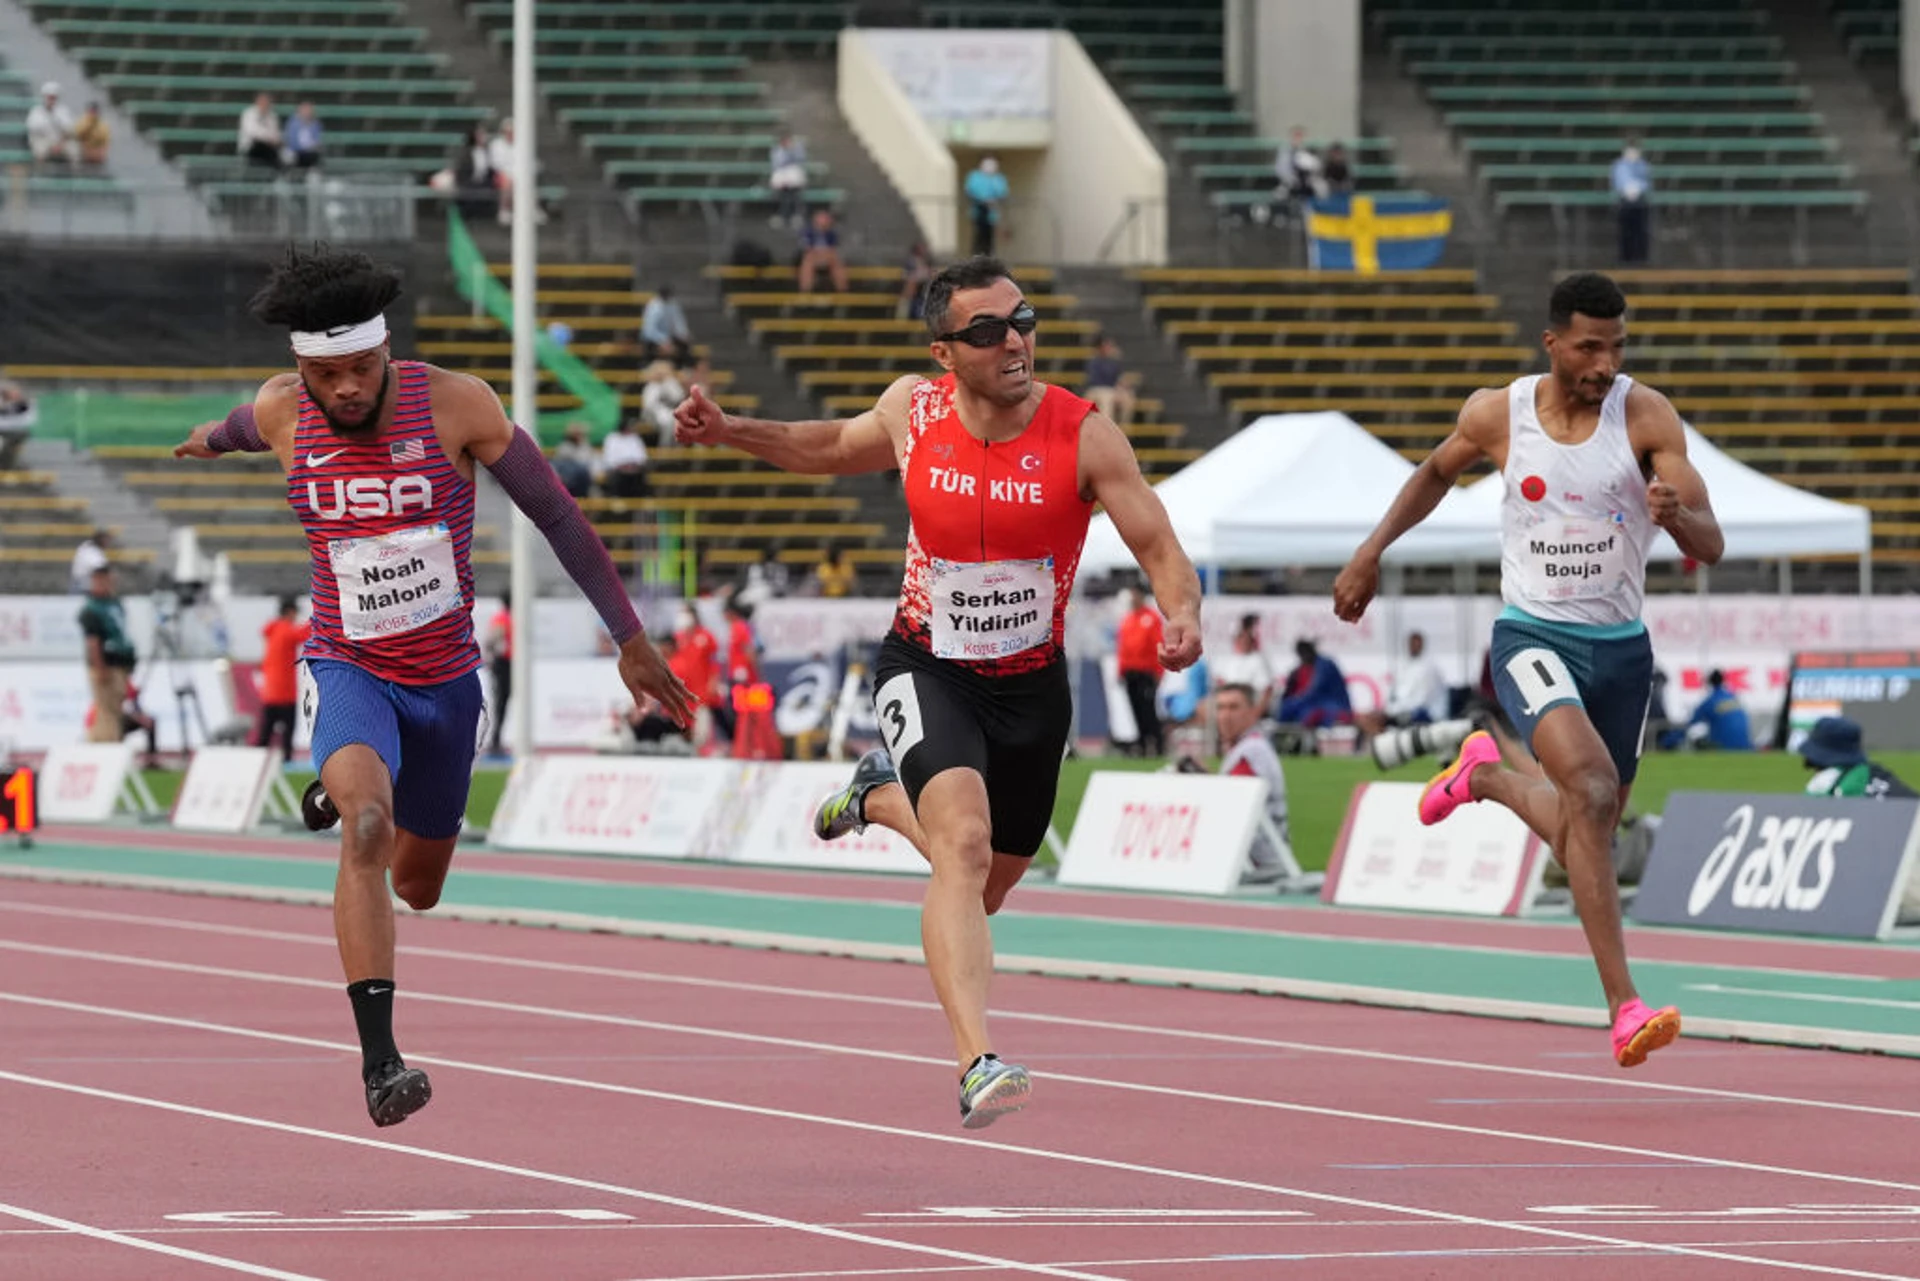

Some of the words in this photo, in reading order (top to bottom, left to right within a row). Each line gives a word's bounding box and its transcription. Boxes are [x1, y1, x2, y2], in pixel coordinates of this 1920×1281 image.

[307, 474, 432, 520] USA
[929, 466, 976, 497] TÜR
[990, 475, 1044, 504] KİYE
[1530, 535, 1614, 556] Mouncef
[361, 557, 425, 586] Noah
[1545, 562, 1603, 579] Bouja
[357, 576, 442, 612] Malone
[951, 586, 1037, 609] Serkan
[374, 613, 412, 633] KOBE
[413, 602, 441, 624] 2024
[948, 608, 1038, 634] Yildirim
[963, 642, 999, 656] KOBE
[1001, 635, 1030, 653] 2024
[883, 699, 906, 749] 3
